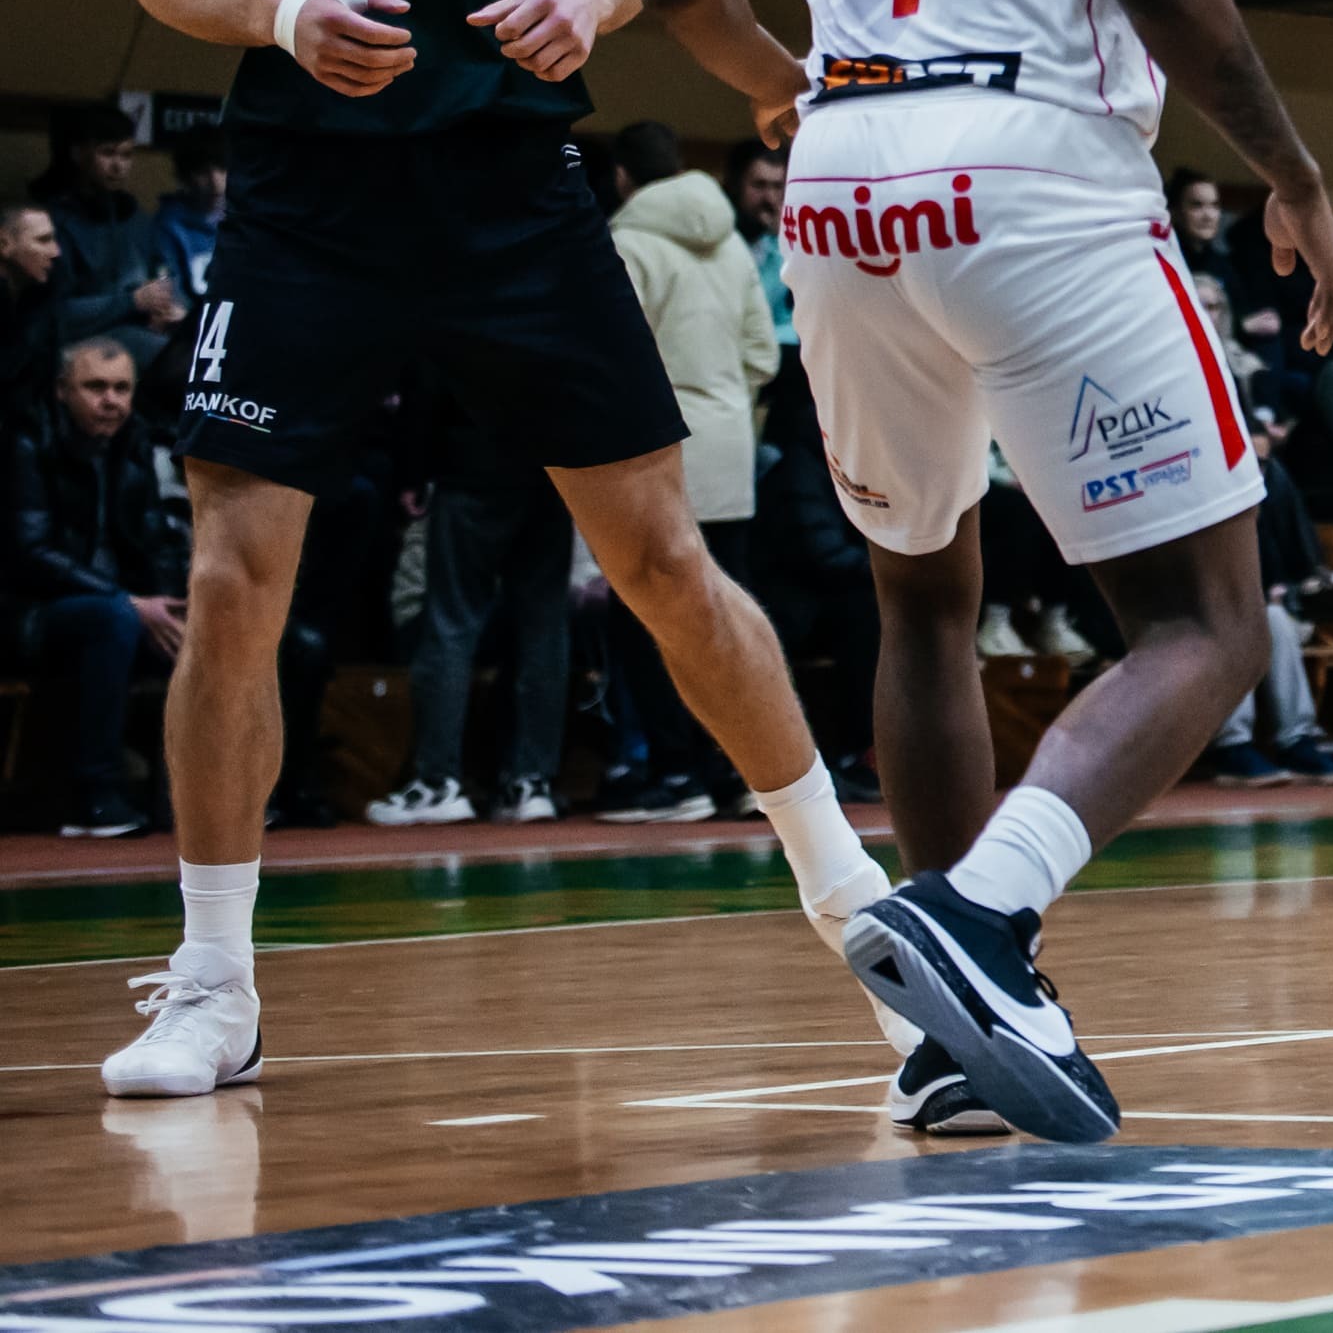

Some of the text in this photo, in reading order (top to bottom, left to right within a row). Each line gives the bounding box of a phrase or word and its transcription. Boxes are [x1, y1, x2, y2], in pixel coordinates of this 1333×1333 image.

[185, 392, 277, 424] RANKOF
[1097, 396, 1172, 443] РДК
[1086, 470, 1137, 503] PST
